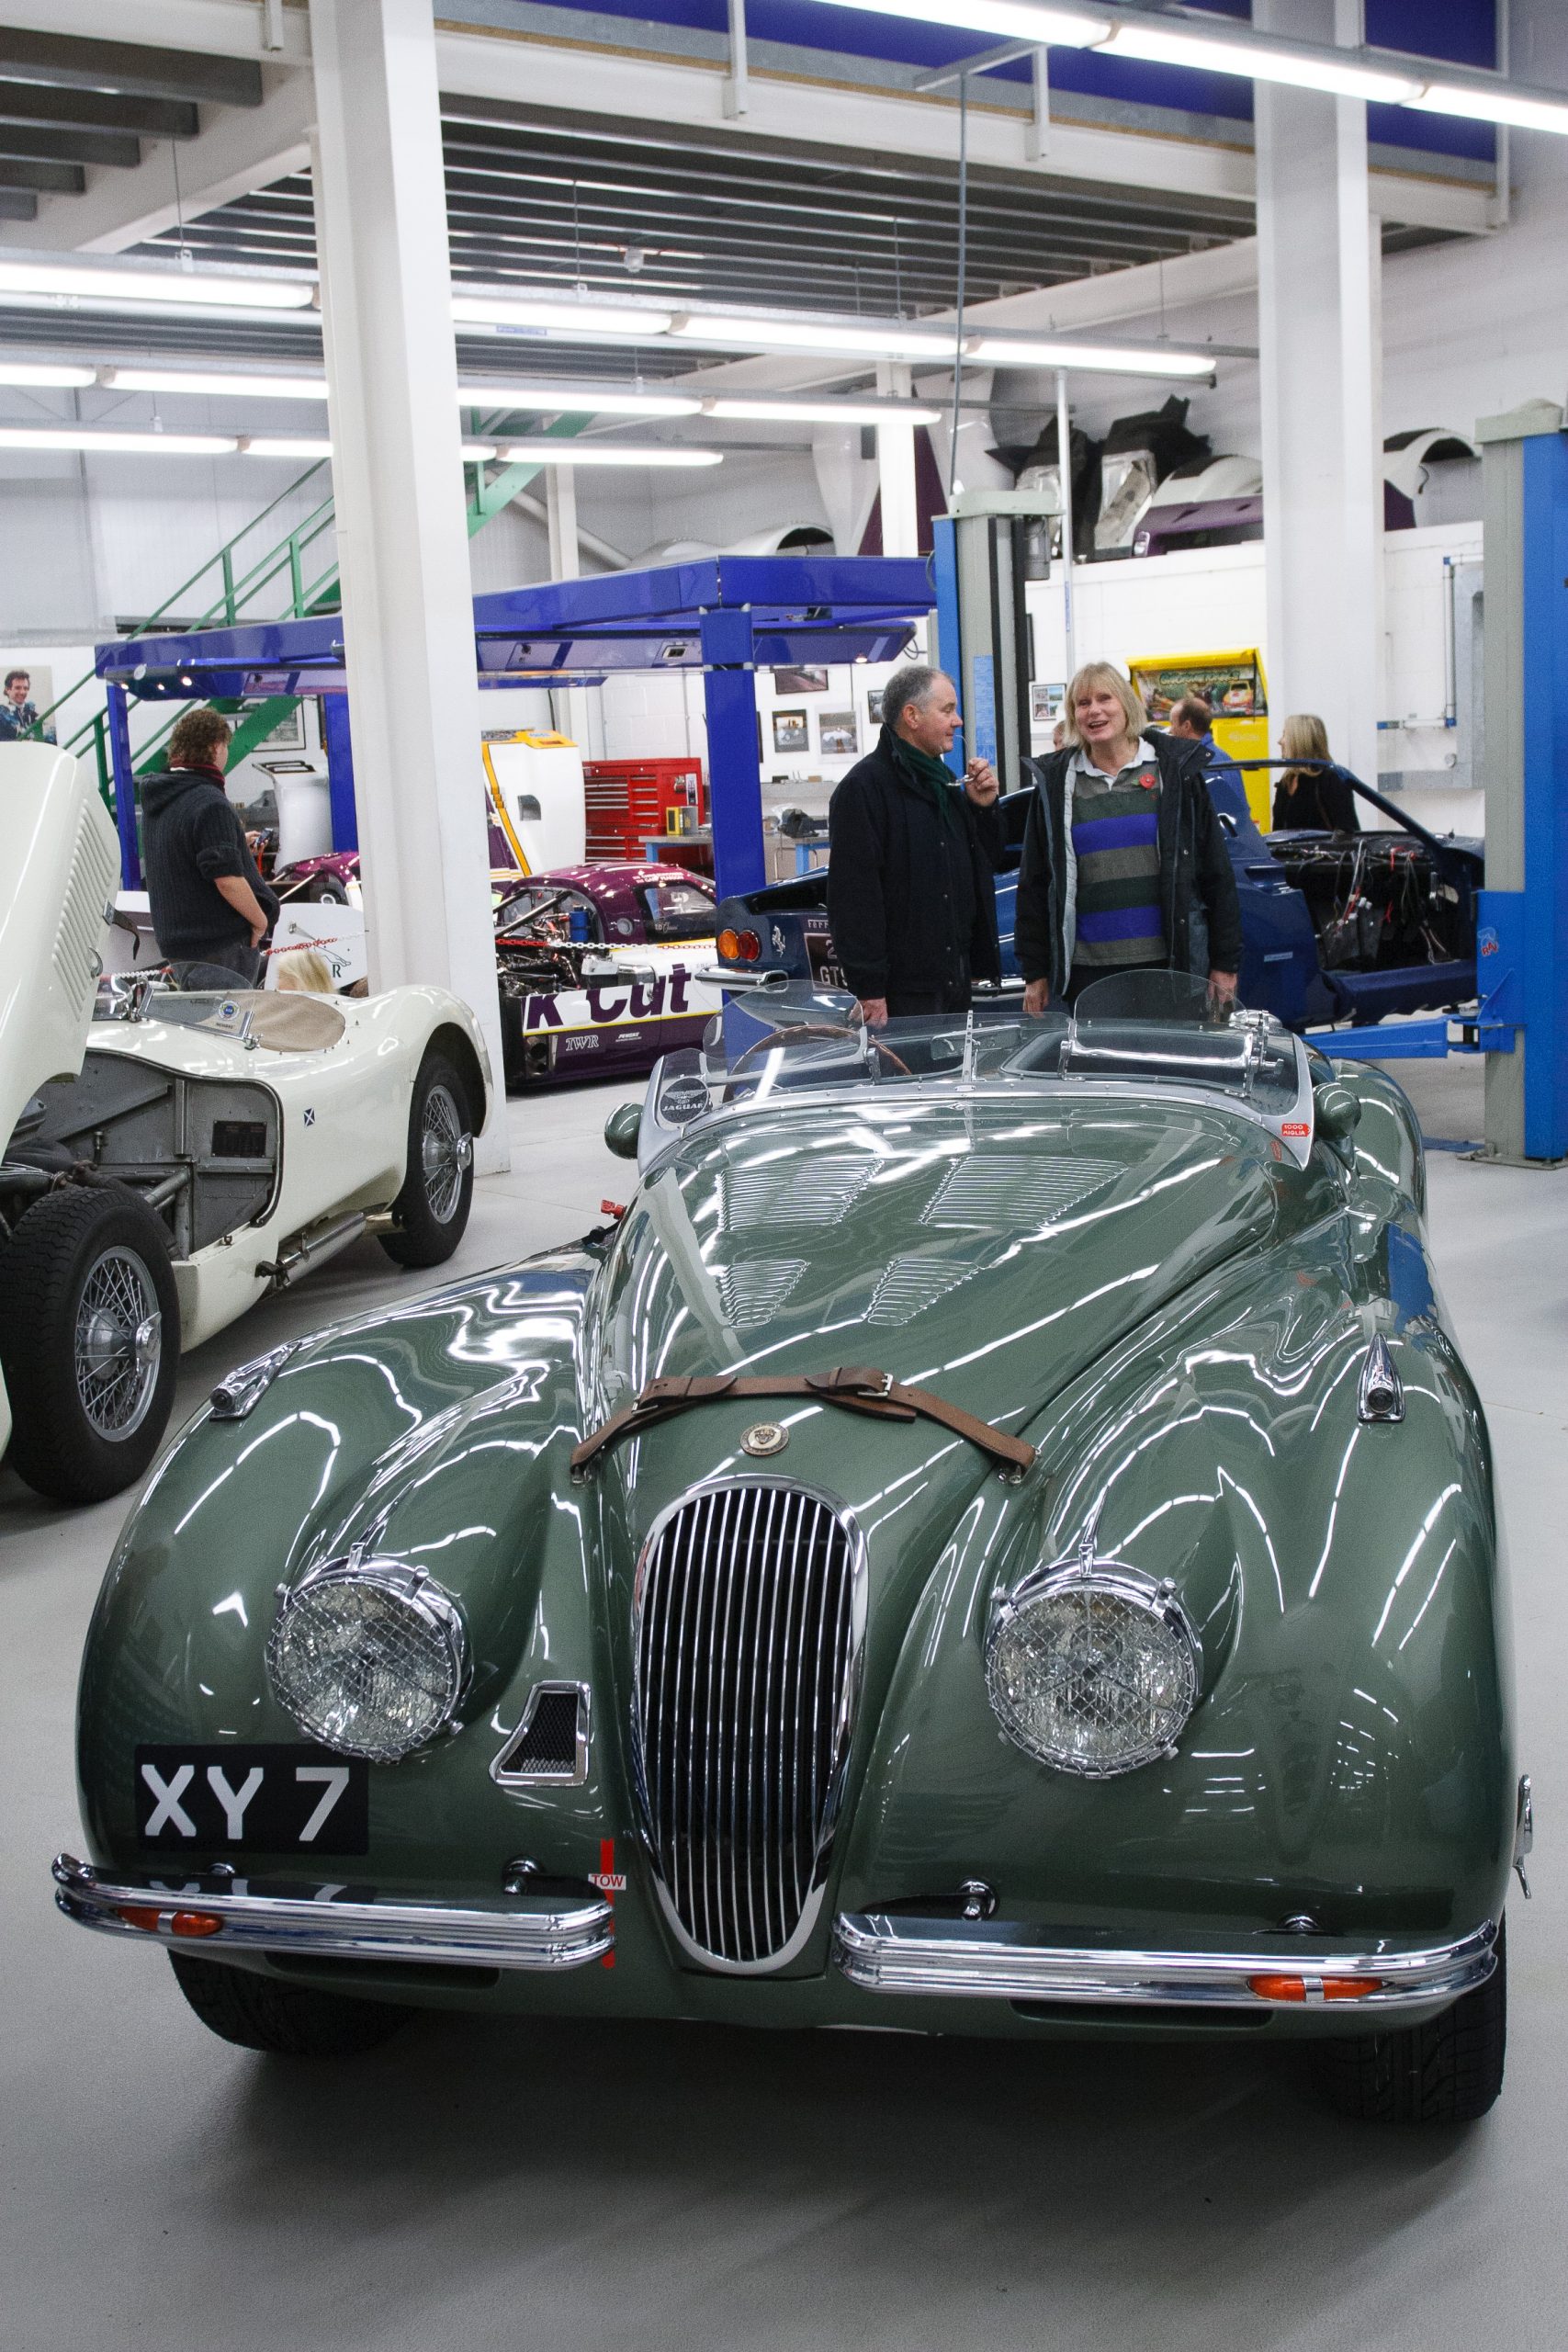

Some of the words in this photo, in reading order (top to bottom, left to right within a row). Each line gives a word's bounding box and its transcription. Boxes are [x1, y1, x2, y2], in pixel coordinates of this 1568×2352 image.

[566, 1035, 600, 1052] TWR
[661, 1102, 704, 1112] JAGUAR
[141, 1764, 265, 1840] XY
[295, 1767, 350, 1841] 7
[591, 1874, 624, 1888] TOW
